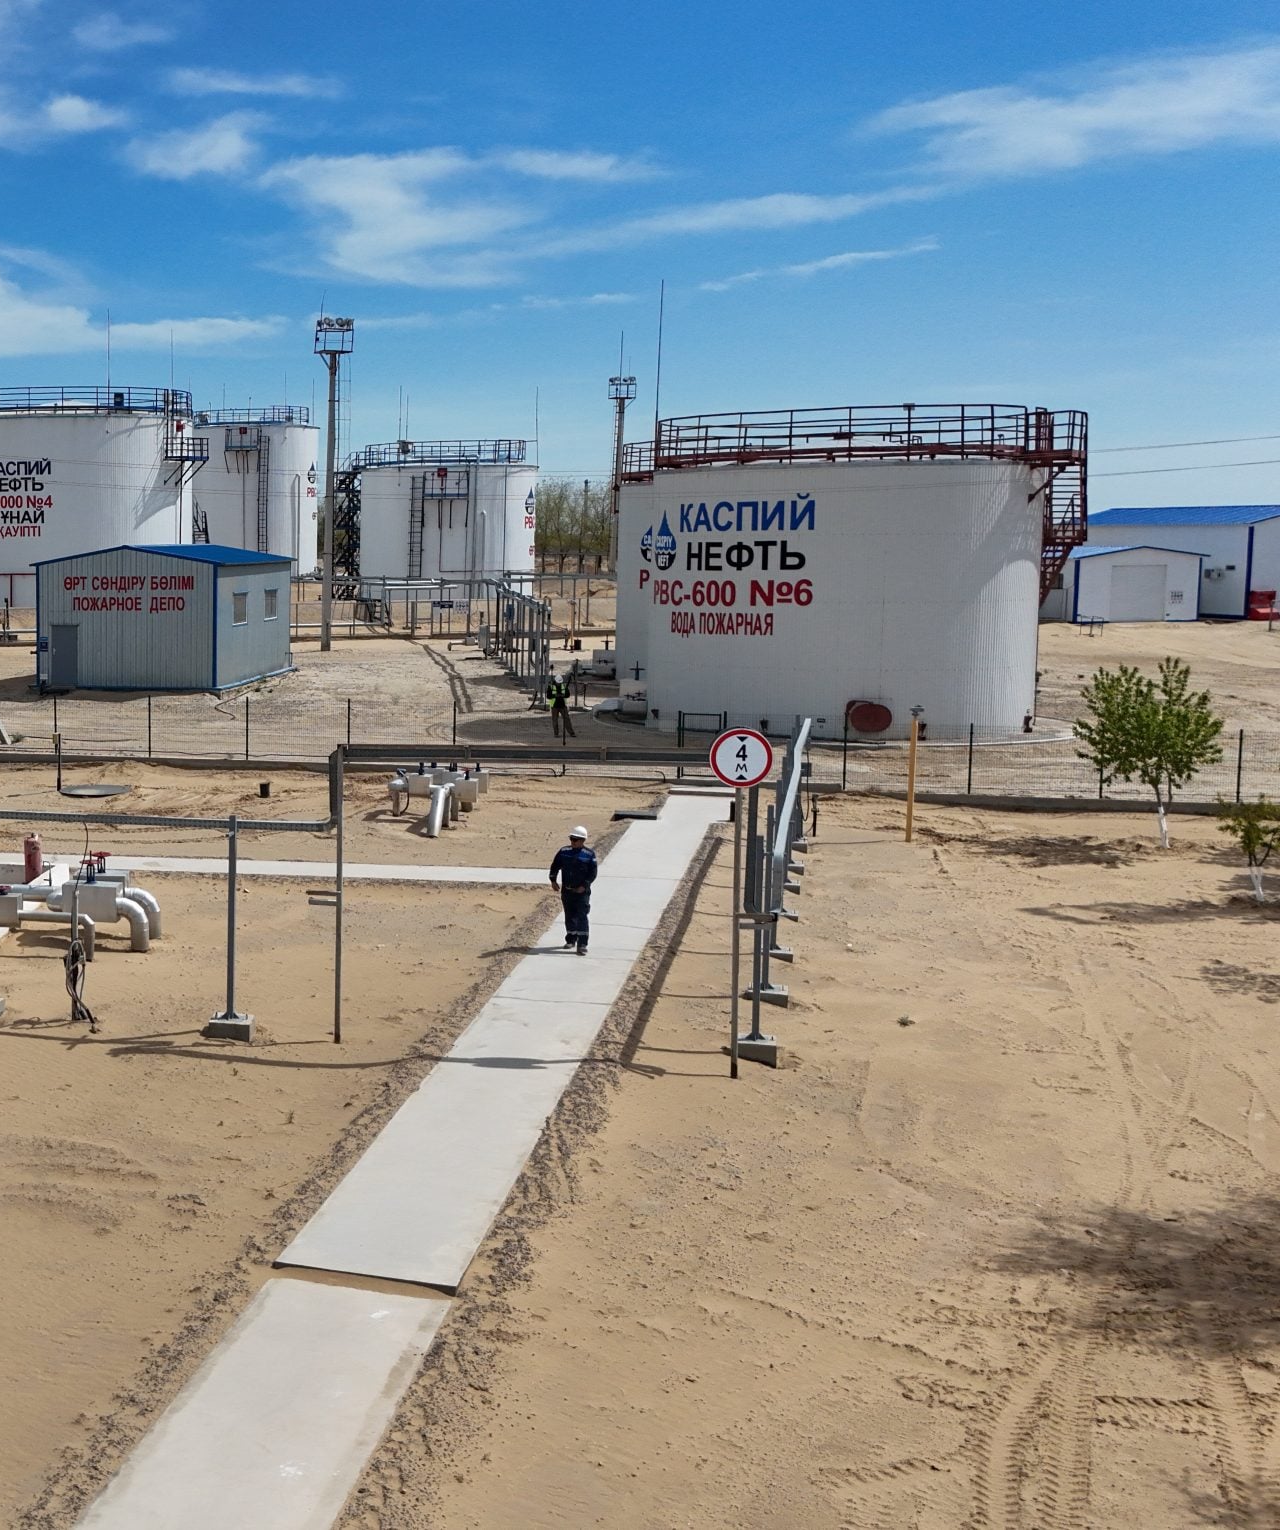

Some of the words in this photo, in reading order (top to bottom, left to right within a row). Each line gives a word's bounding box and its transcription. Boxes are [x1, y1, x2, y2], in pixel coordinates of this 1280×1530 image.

[26, 495, 53, 508] №4
[679, 492, 816, 532] КАСПИЙ
[686, 540, 806, 571] НЕФТЬ
[63, 576, 87, 591] ӨРТ
[91, 576, 146, 593] СӨНДІРУ
[150, 575, 195, 590] БӨЛІМІ
[653, 579, 736, 606] РВС-600
[750, 578, 814, 606] №6
[73, 596, 142, 611] ПОЖАРНОЕ
[149, 596, 185, 614] ДЕПО
[671, 611, 695, 638] ВОДА
[699, 612, 774, 636] ПОЖАРНАЯ
[735, 744, 748, 761] 4
